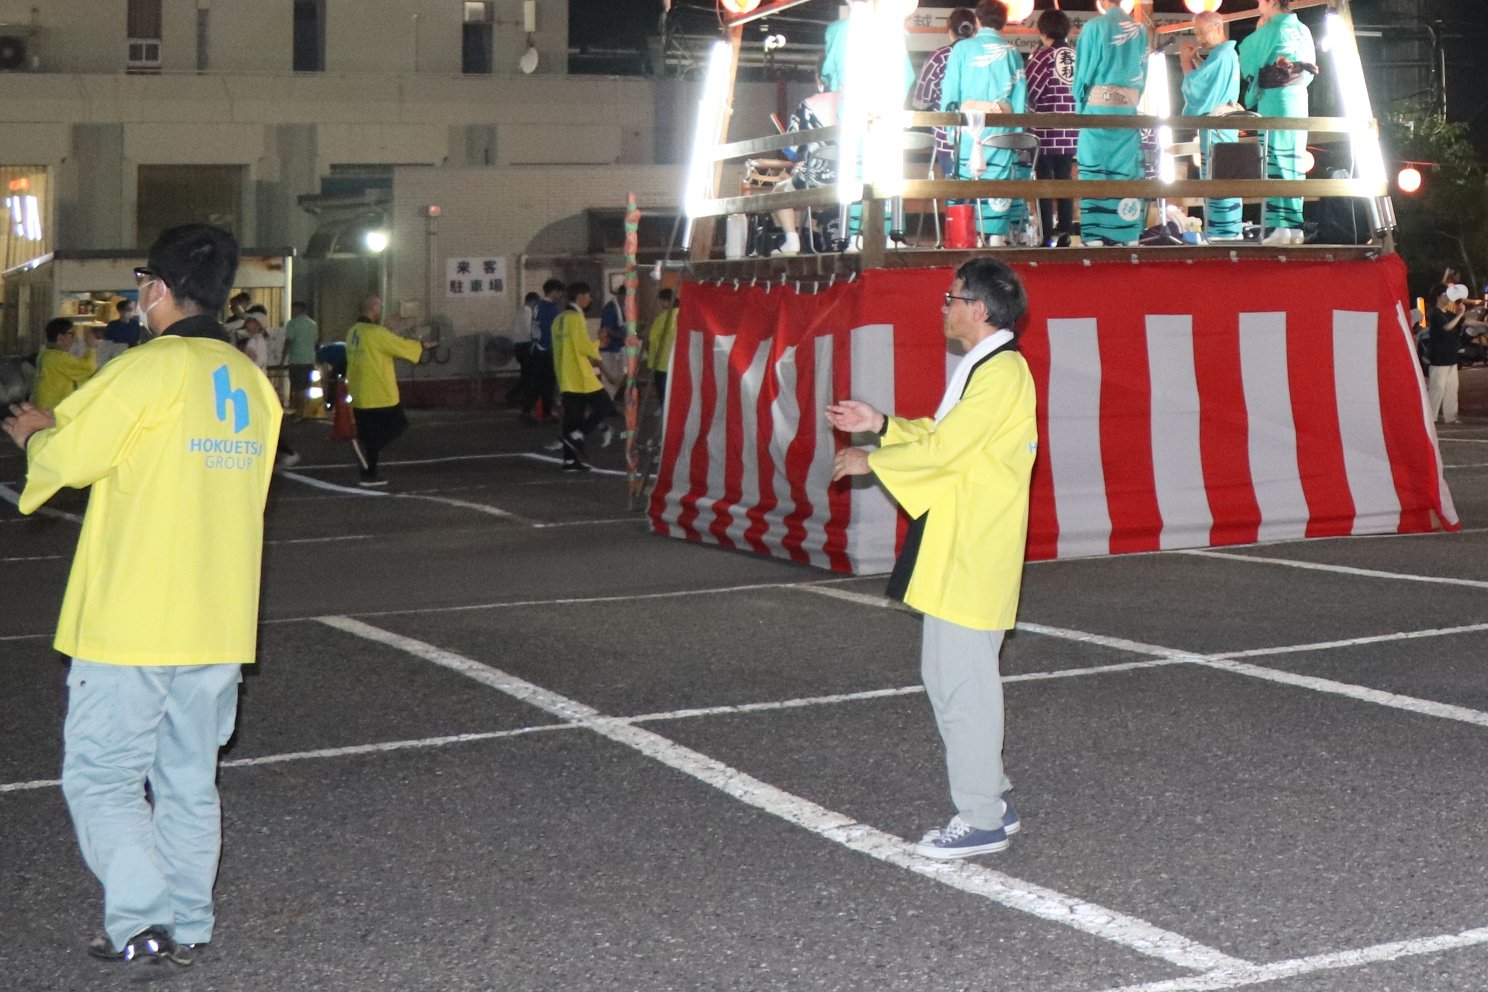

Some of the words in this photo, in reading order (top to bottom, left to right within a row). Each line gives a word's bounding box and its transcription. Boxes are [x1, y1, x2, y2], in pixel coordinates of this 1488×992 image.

[457, 260, 497, 275] 来客
[450, 279, 504, 293] 駐車場
[205, 455, 253, 469] GROUP
